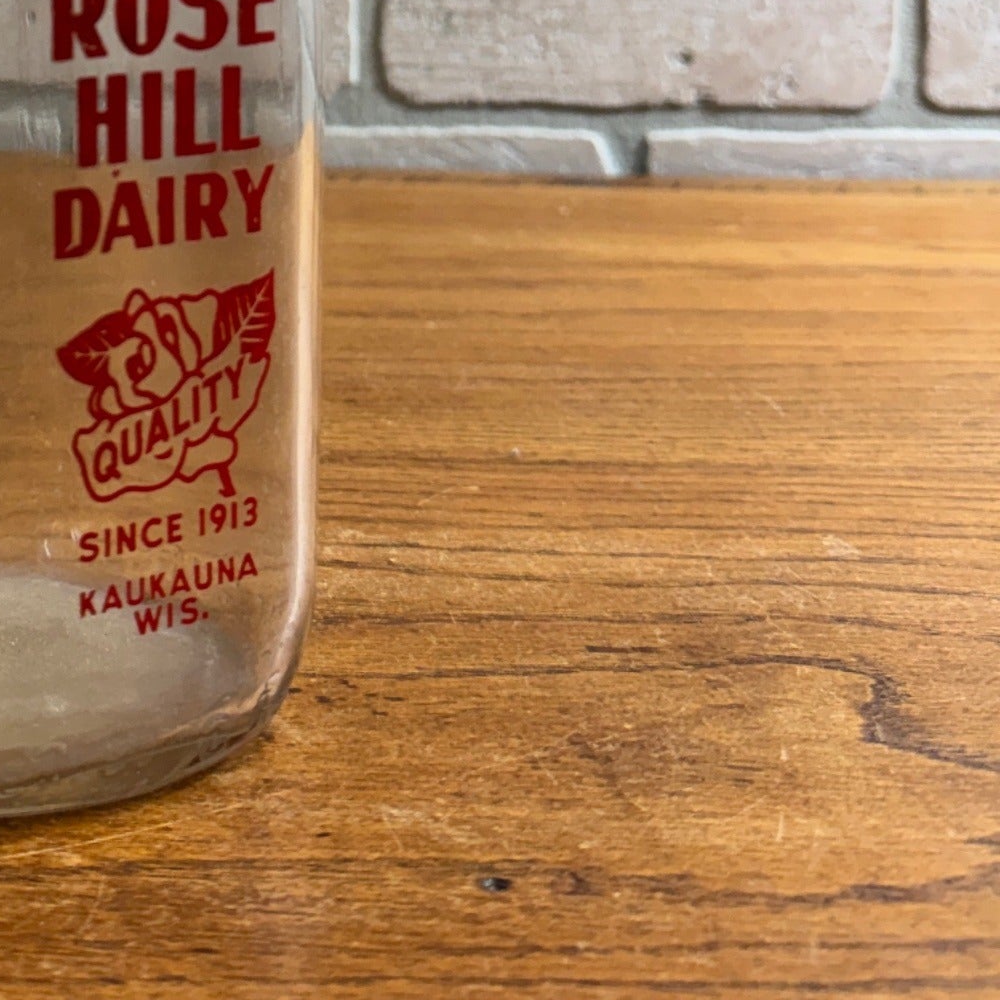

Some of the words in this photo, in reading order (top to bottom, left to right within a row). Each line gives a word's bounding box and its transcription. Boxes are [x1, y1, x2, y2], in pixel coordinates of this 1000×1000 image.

[76, 64, 261, 169] HILL
[53, 164, 275, 261] DAIRY
[93, 356, 246, 483] QUALITY
[78, 512, 184, 562] SINCE
[198, 496, 259, 537] 1913
[79, 552, 259, 618] KAUKAUNA
[134, 597, 210, 636] WIS.
